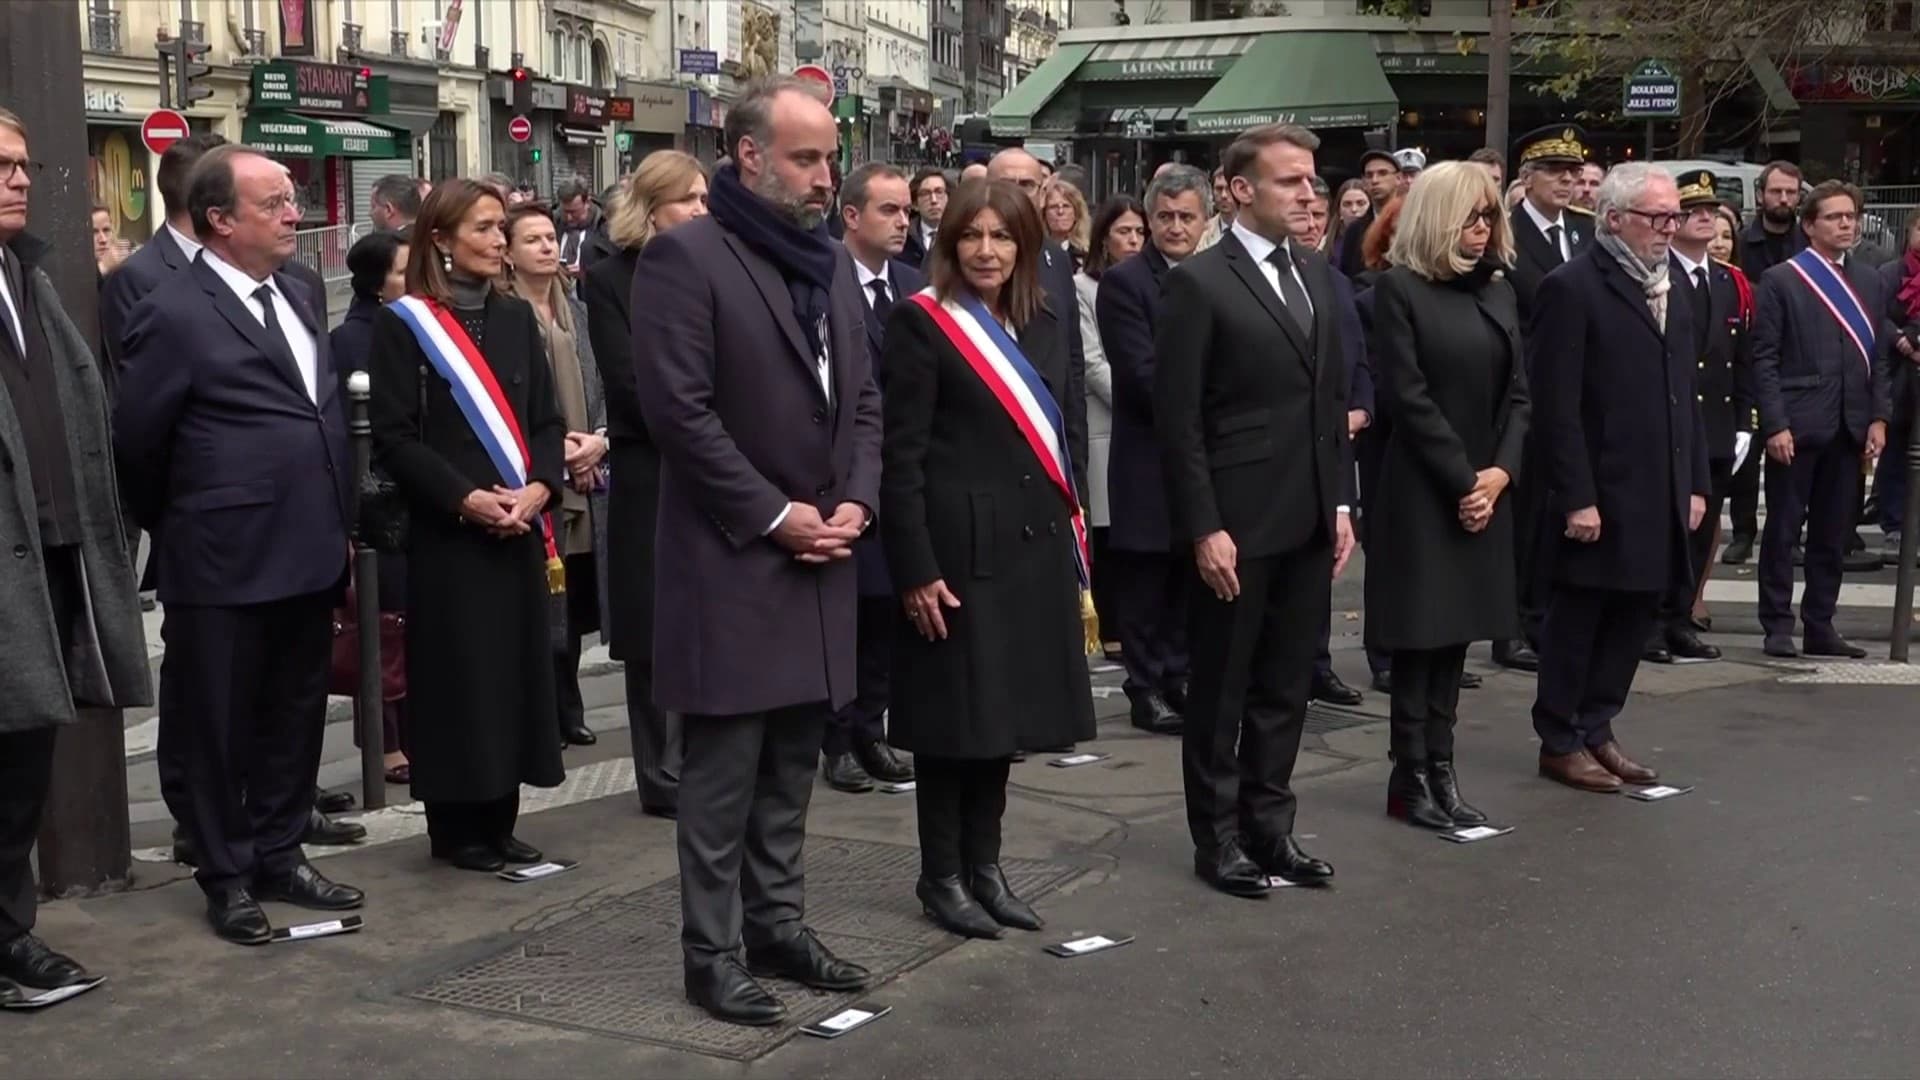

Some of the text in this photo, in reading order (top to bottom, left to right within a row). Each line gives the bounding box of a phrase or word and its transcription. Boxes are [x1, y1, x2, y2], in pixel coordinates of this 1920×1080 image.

[1122, 63, 1138, 73] LA
[1140, 60, 1177, 72] BONNE
[297, 64, 353, 95] STAURANT
[263, 82, 288, 90] ORIENT
[1631, 85, 1674, 95] BOULEVARD
[261, 92, 292, 100] EXPRESS
[1627, 98, 1677, 108] JULES FERRY
[1198, 118, 1232, 129] Service
[1233, 114, 1272, 125] continu
[284, 143, 314, 154] BURGER
